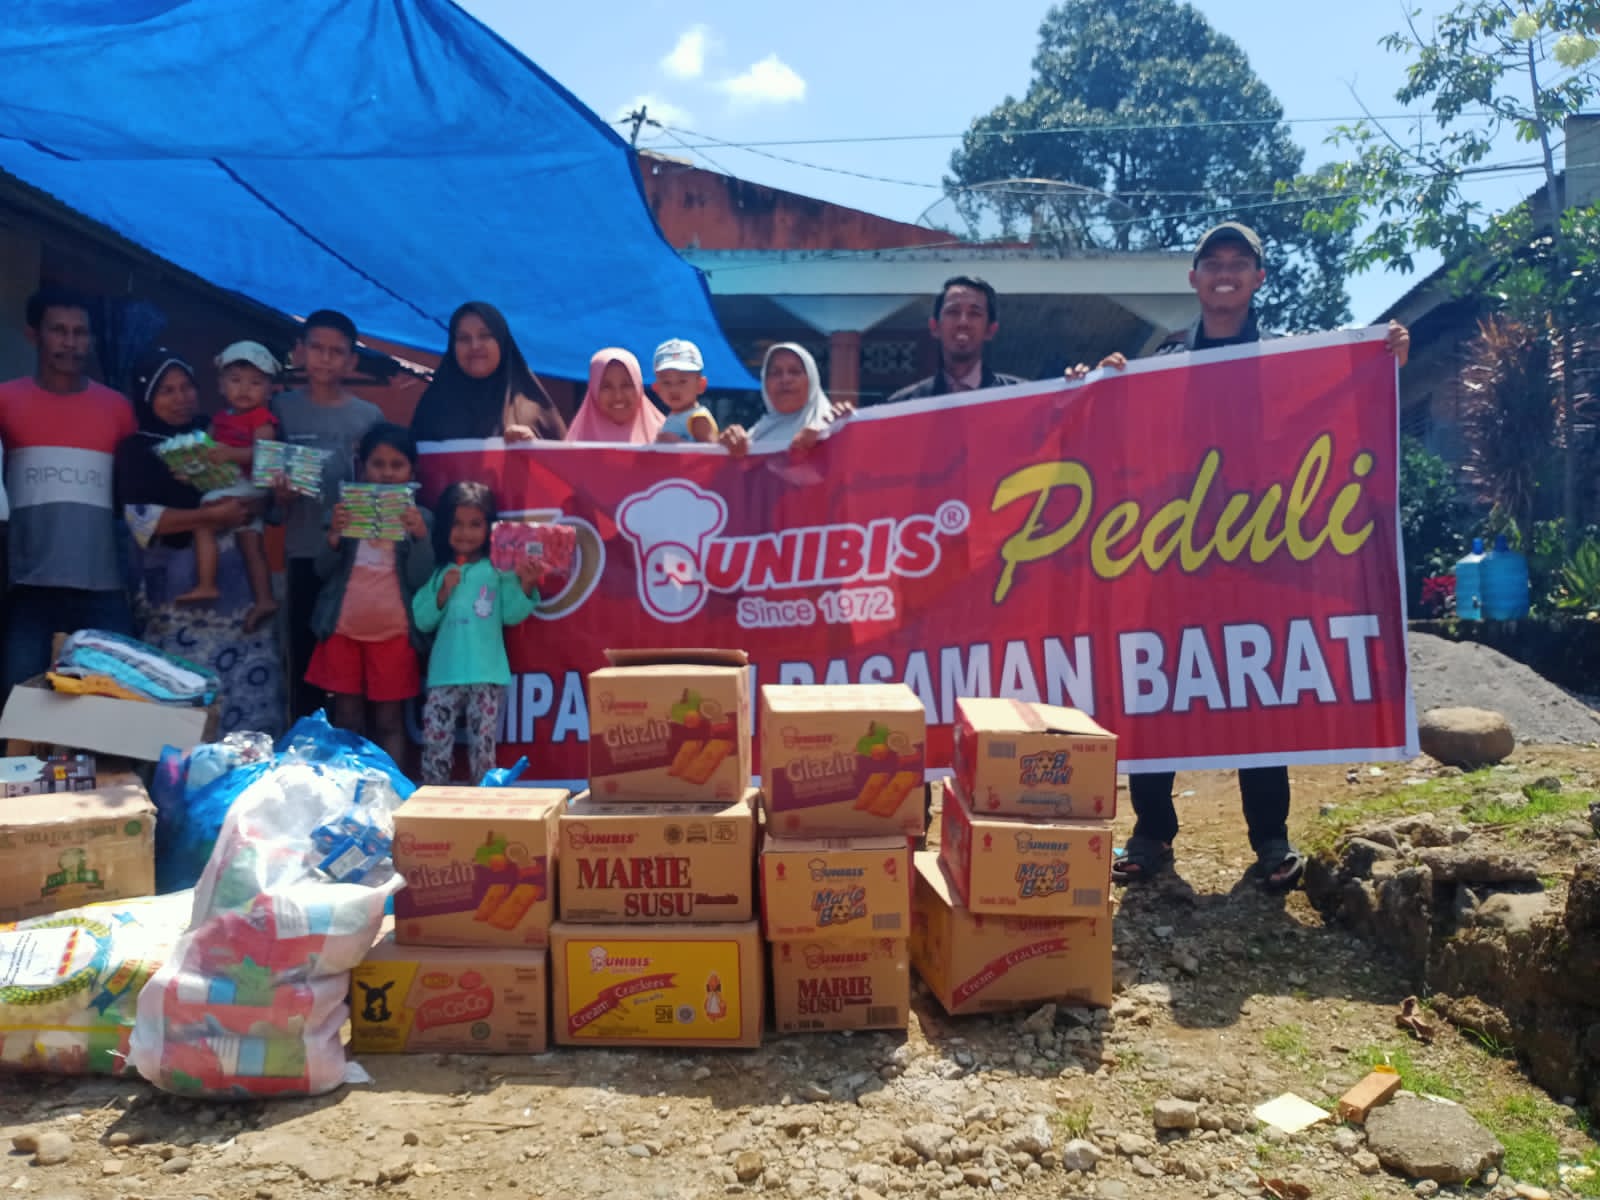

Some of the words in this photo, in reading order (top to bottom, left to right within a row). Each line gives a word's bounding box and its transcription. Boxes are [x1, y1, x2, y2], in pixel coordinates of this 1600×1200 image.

[991, 433, 1375, 603] Peduli
[740, 599, 813, 624] Since
[821, 590, 893, 619] 1972
[1119, 614, 1380, 715] BARAT
[576, 857, 692, 889] MARIE
[624, 893, 693, 917] SUSU
[798, 976, 873, 997] MARIE
